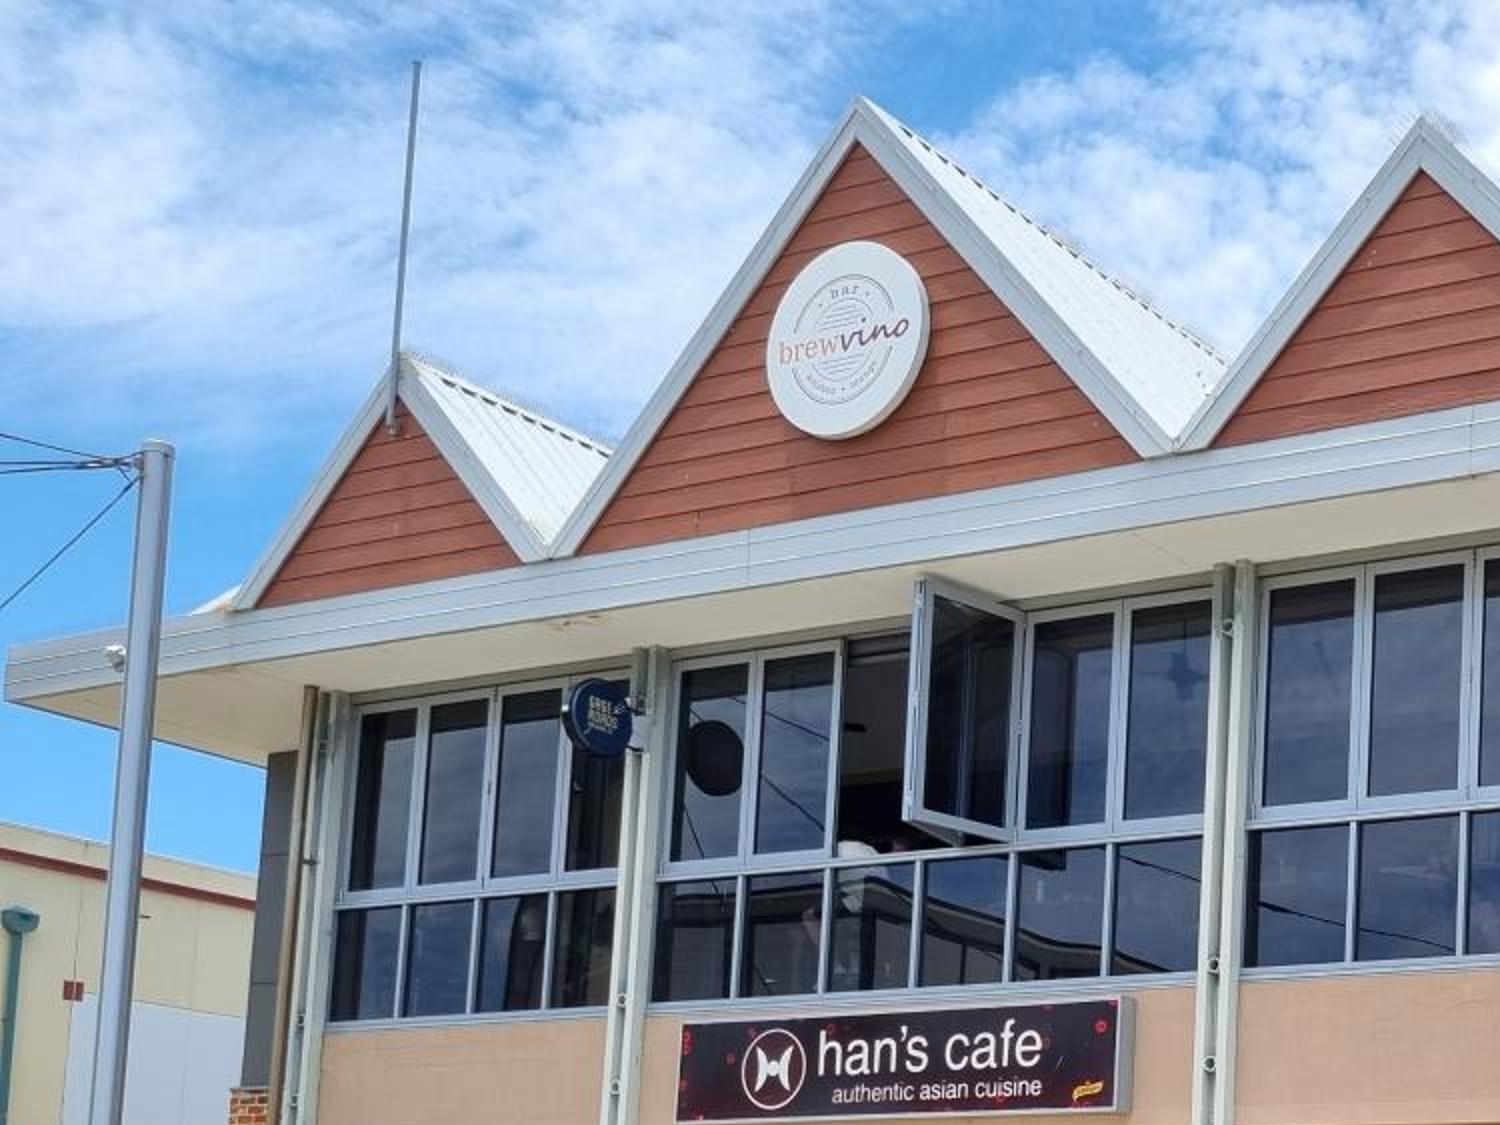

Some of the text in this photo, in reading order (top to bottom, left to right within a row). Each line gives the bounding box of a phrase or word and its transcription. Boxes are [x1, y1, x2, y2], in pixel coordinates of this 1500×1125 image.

[778, 318, 910, 365] brewvino
[817, 1018, 1043, 1077] han's cafe
[831, 1076, 1042, 1104] authentic asian cuisine
